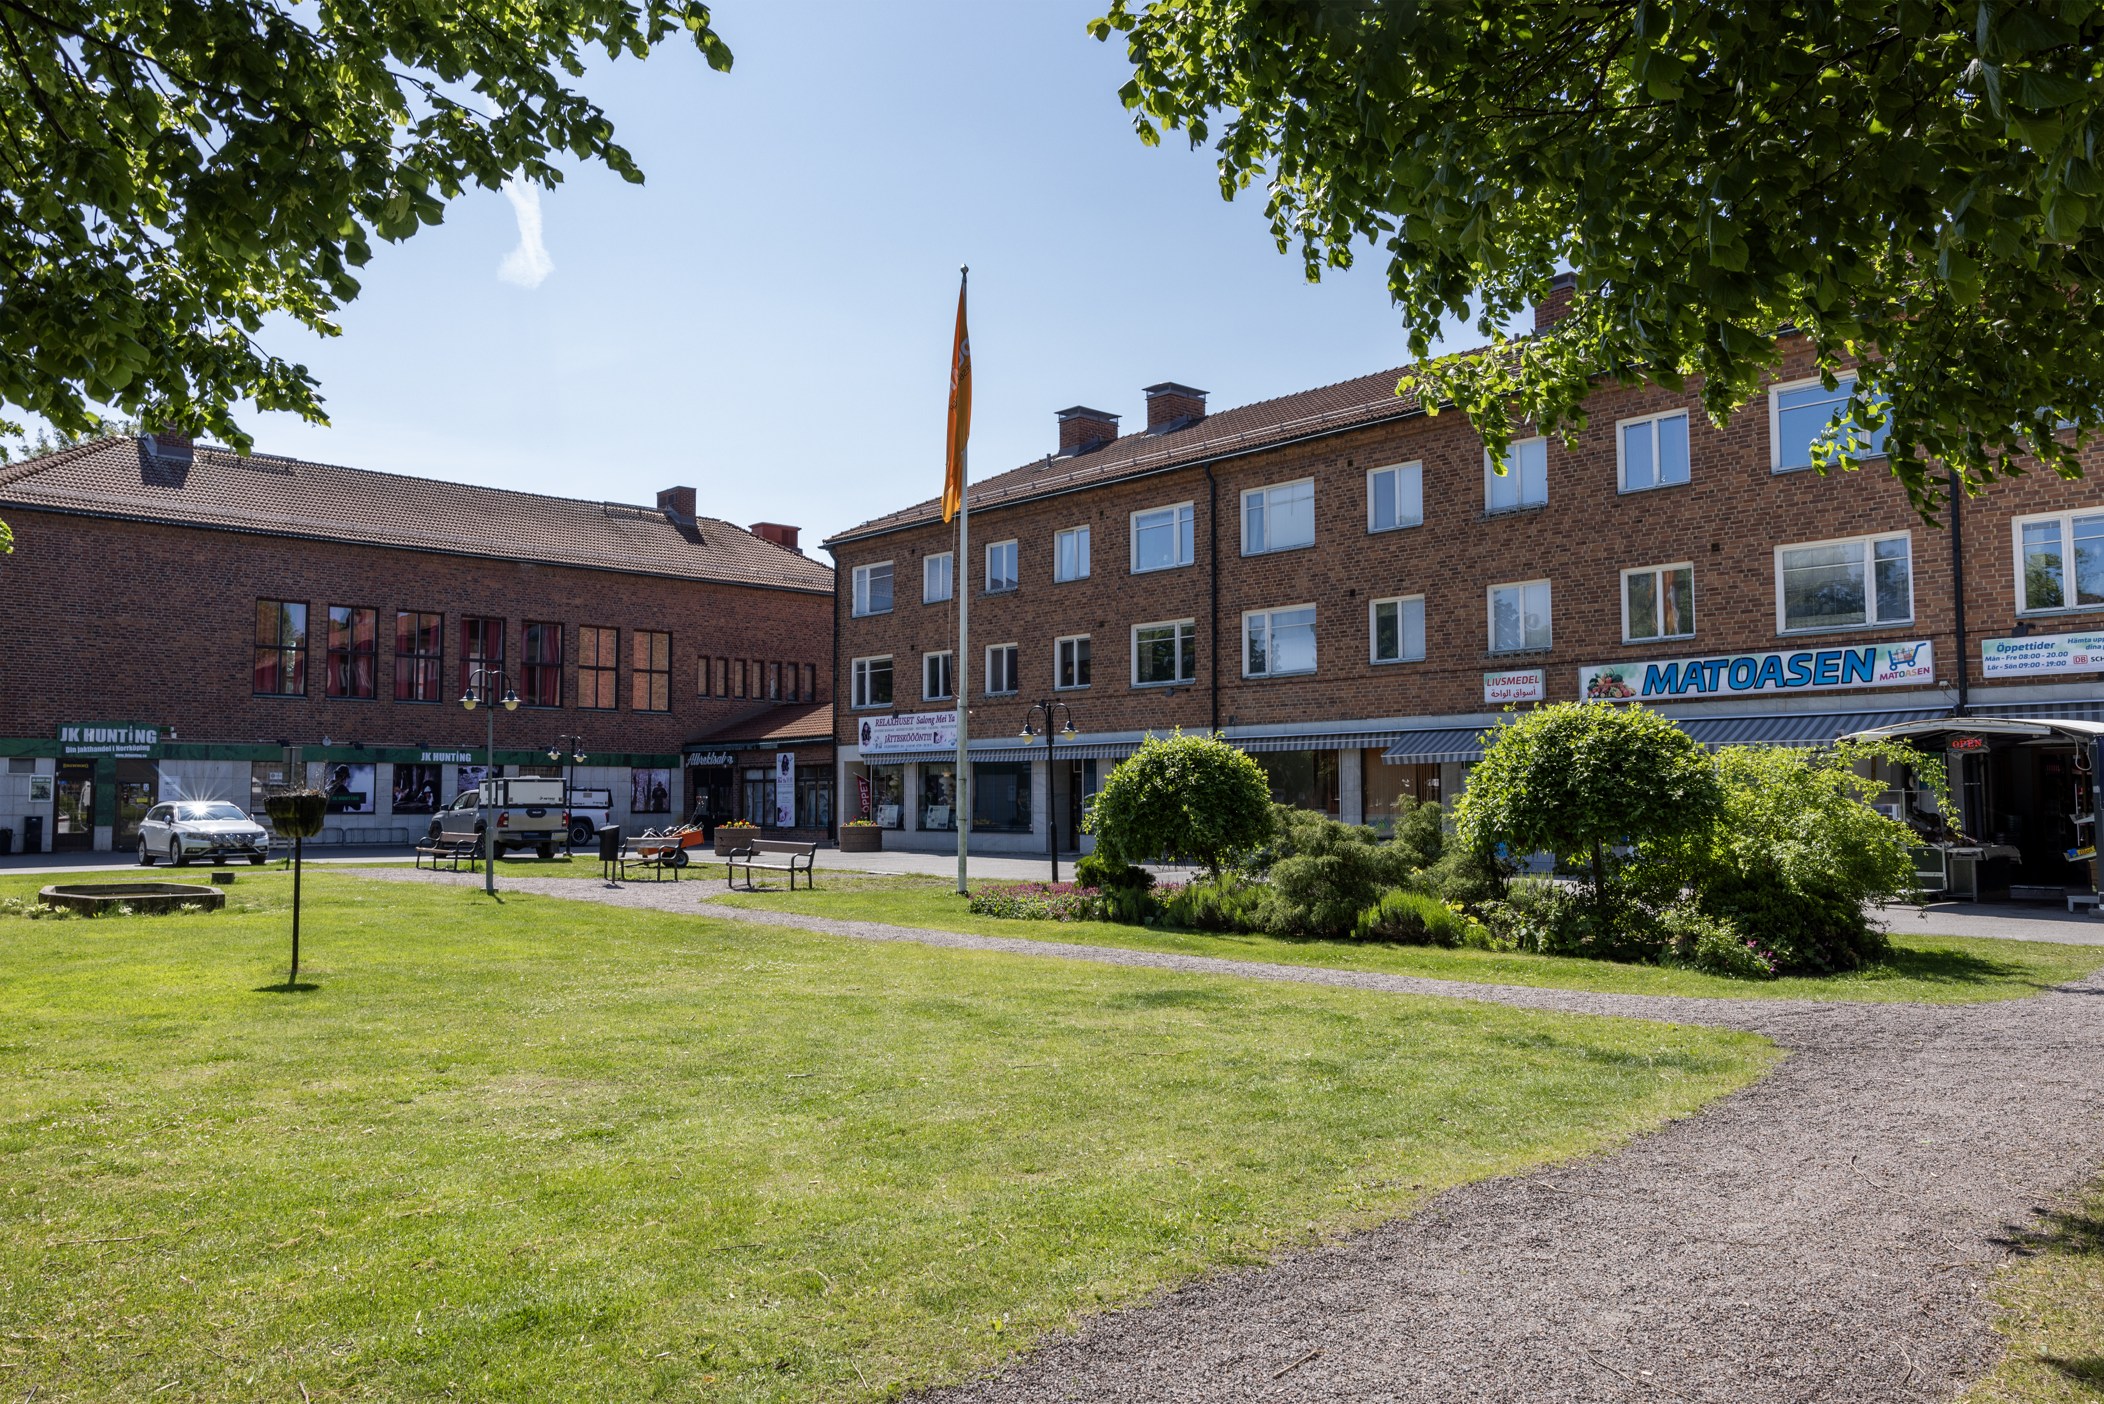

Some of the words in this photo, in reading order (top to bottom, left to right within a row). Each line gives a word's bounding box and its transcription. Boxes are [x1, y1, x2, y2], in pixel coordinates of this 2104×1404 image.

[1996, 641, 2056, 654] Öppettider
[1641, 648, 1877, 696] MATOASEN
[1880, 666, 1930, 681] MATOASEN
[1486, 675, 1540, 686] LIVSMEDEL
[875, 716, 915, 727] RELAXHUSET
[916, 716, 934, 726] Salong
[936, 715, 946, 723] Mei
[60, 728, 80, 742] JK
[1952, 739, 1982, 748] OPEN
[421, 752, 431, 761] JK
